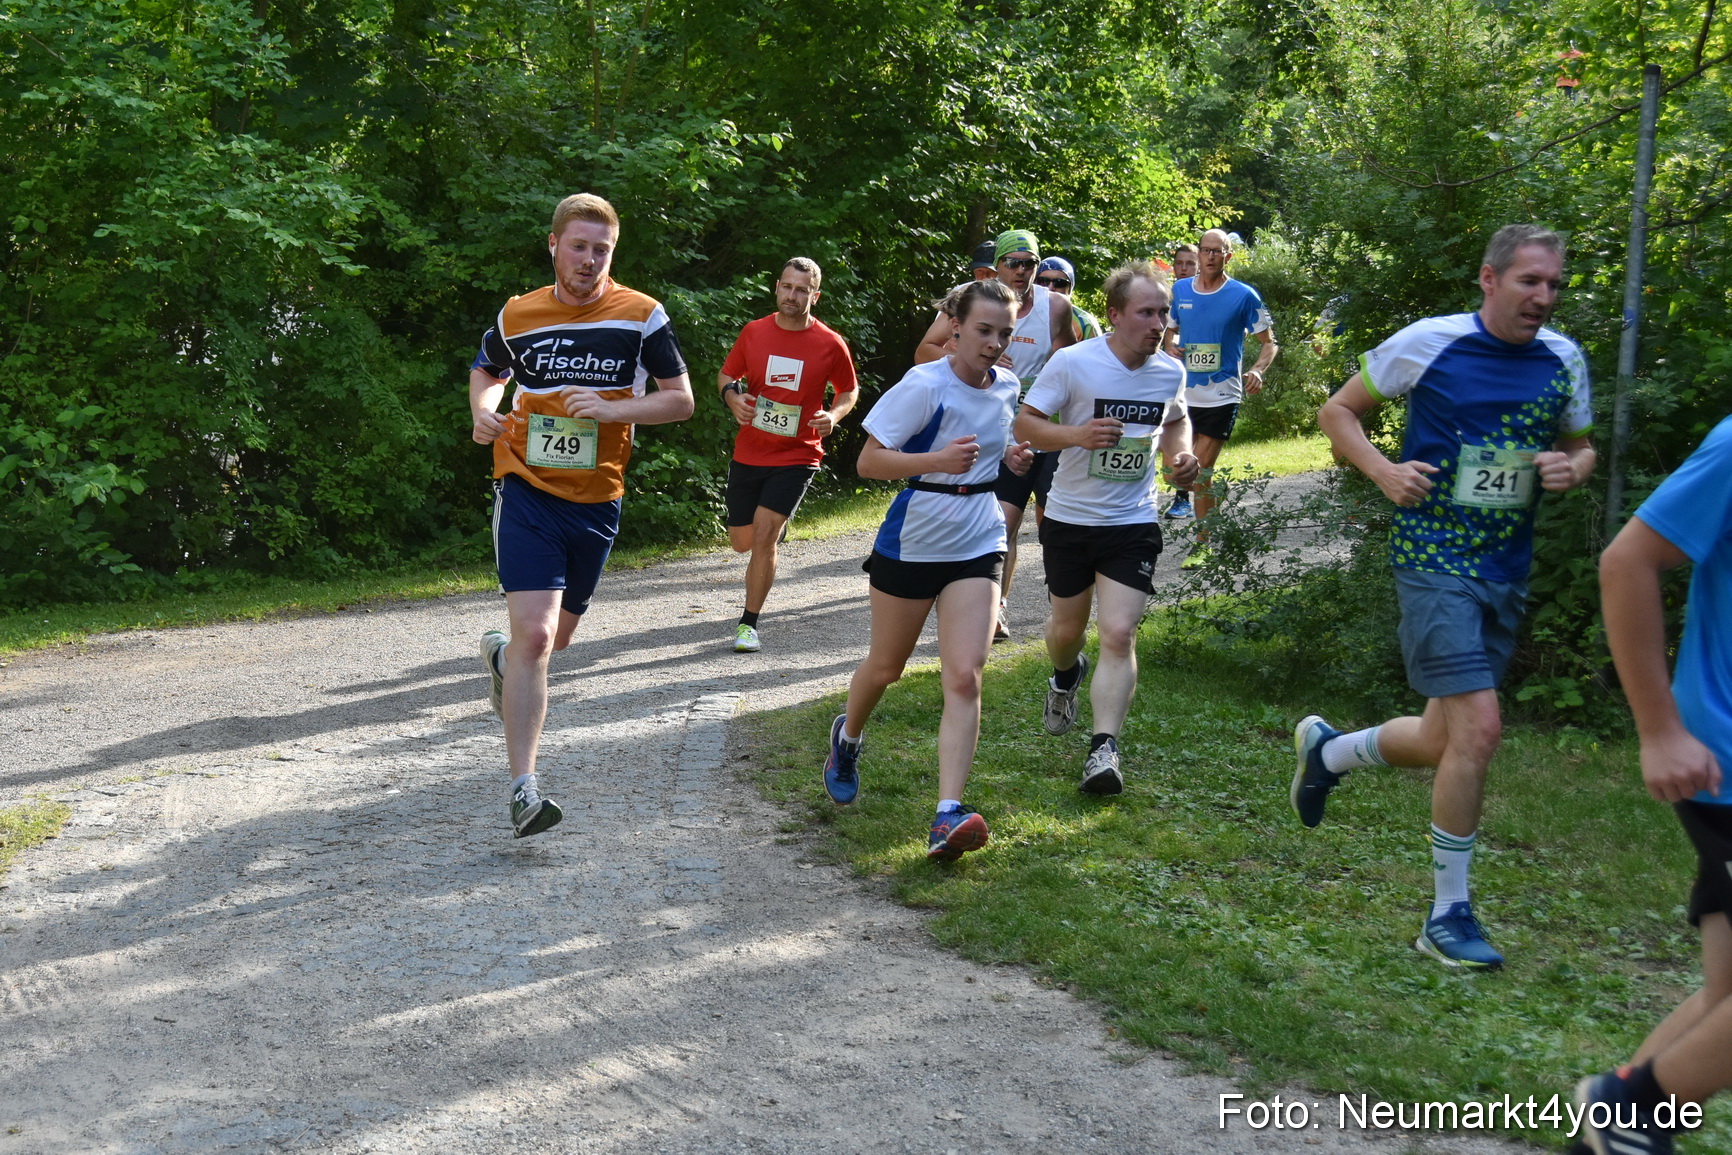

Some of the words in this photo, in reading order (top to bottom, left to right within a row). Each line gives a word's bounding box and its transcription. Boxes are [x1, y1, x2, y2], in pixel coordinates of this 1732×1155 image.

[535, 353, 626, 372] Fischer
[1188, 353, 1216, 364] 1082
[544, 371, 618, 382] AUTOMOBILE
[762, 411, 789, 427] 543
[541, 434, 581, 455] 749
[1099, 450, 1144, 470] 1520
[1473, 469, 1519, 492] 241
